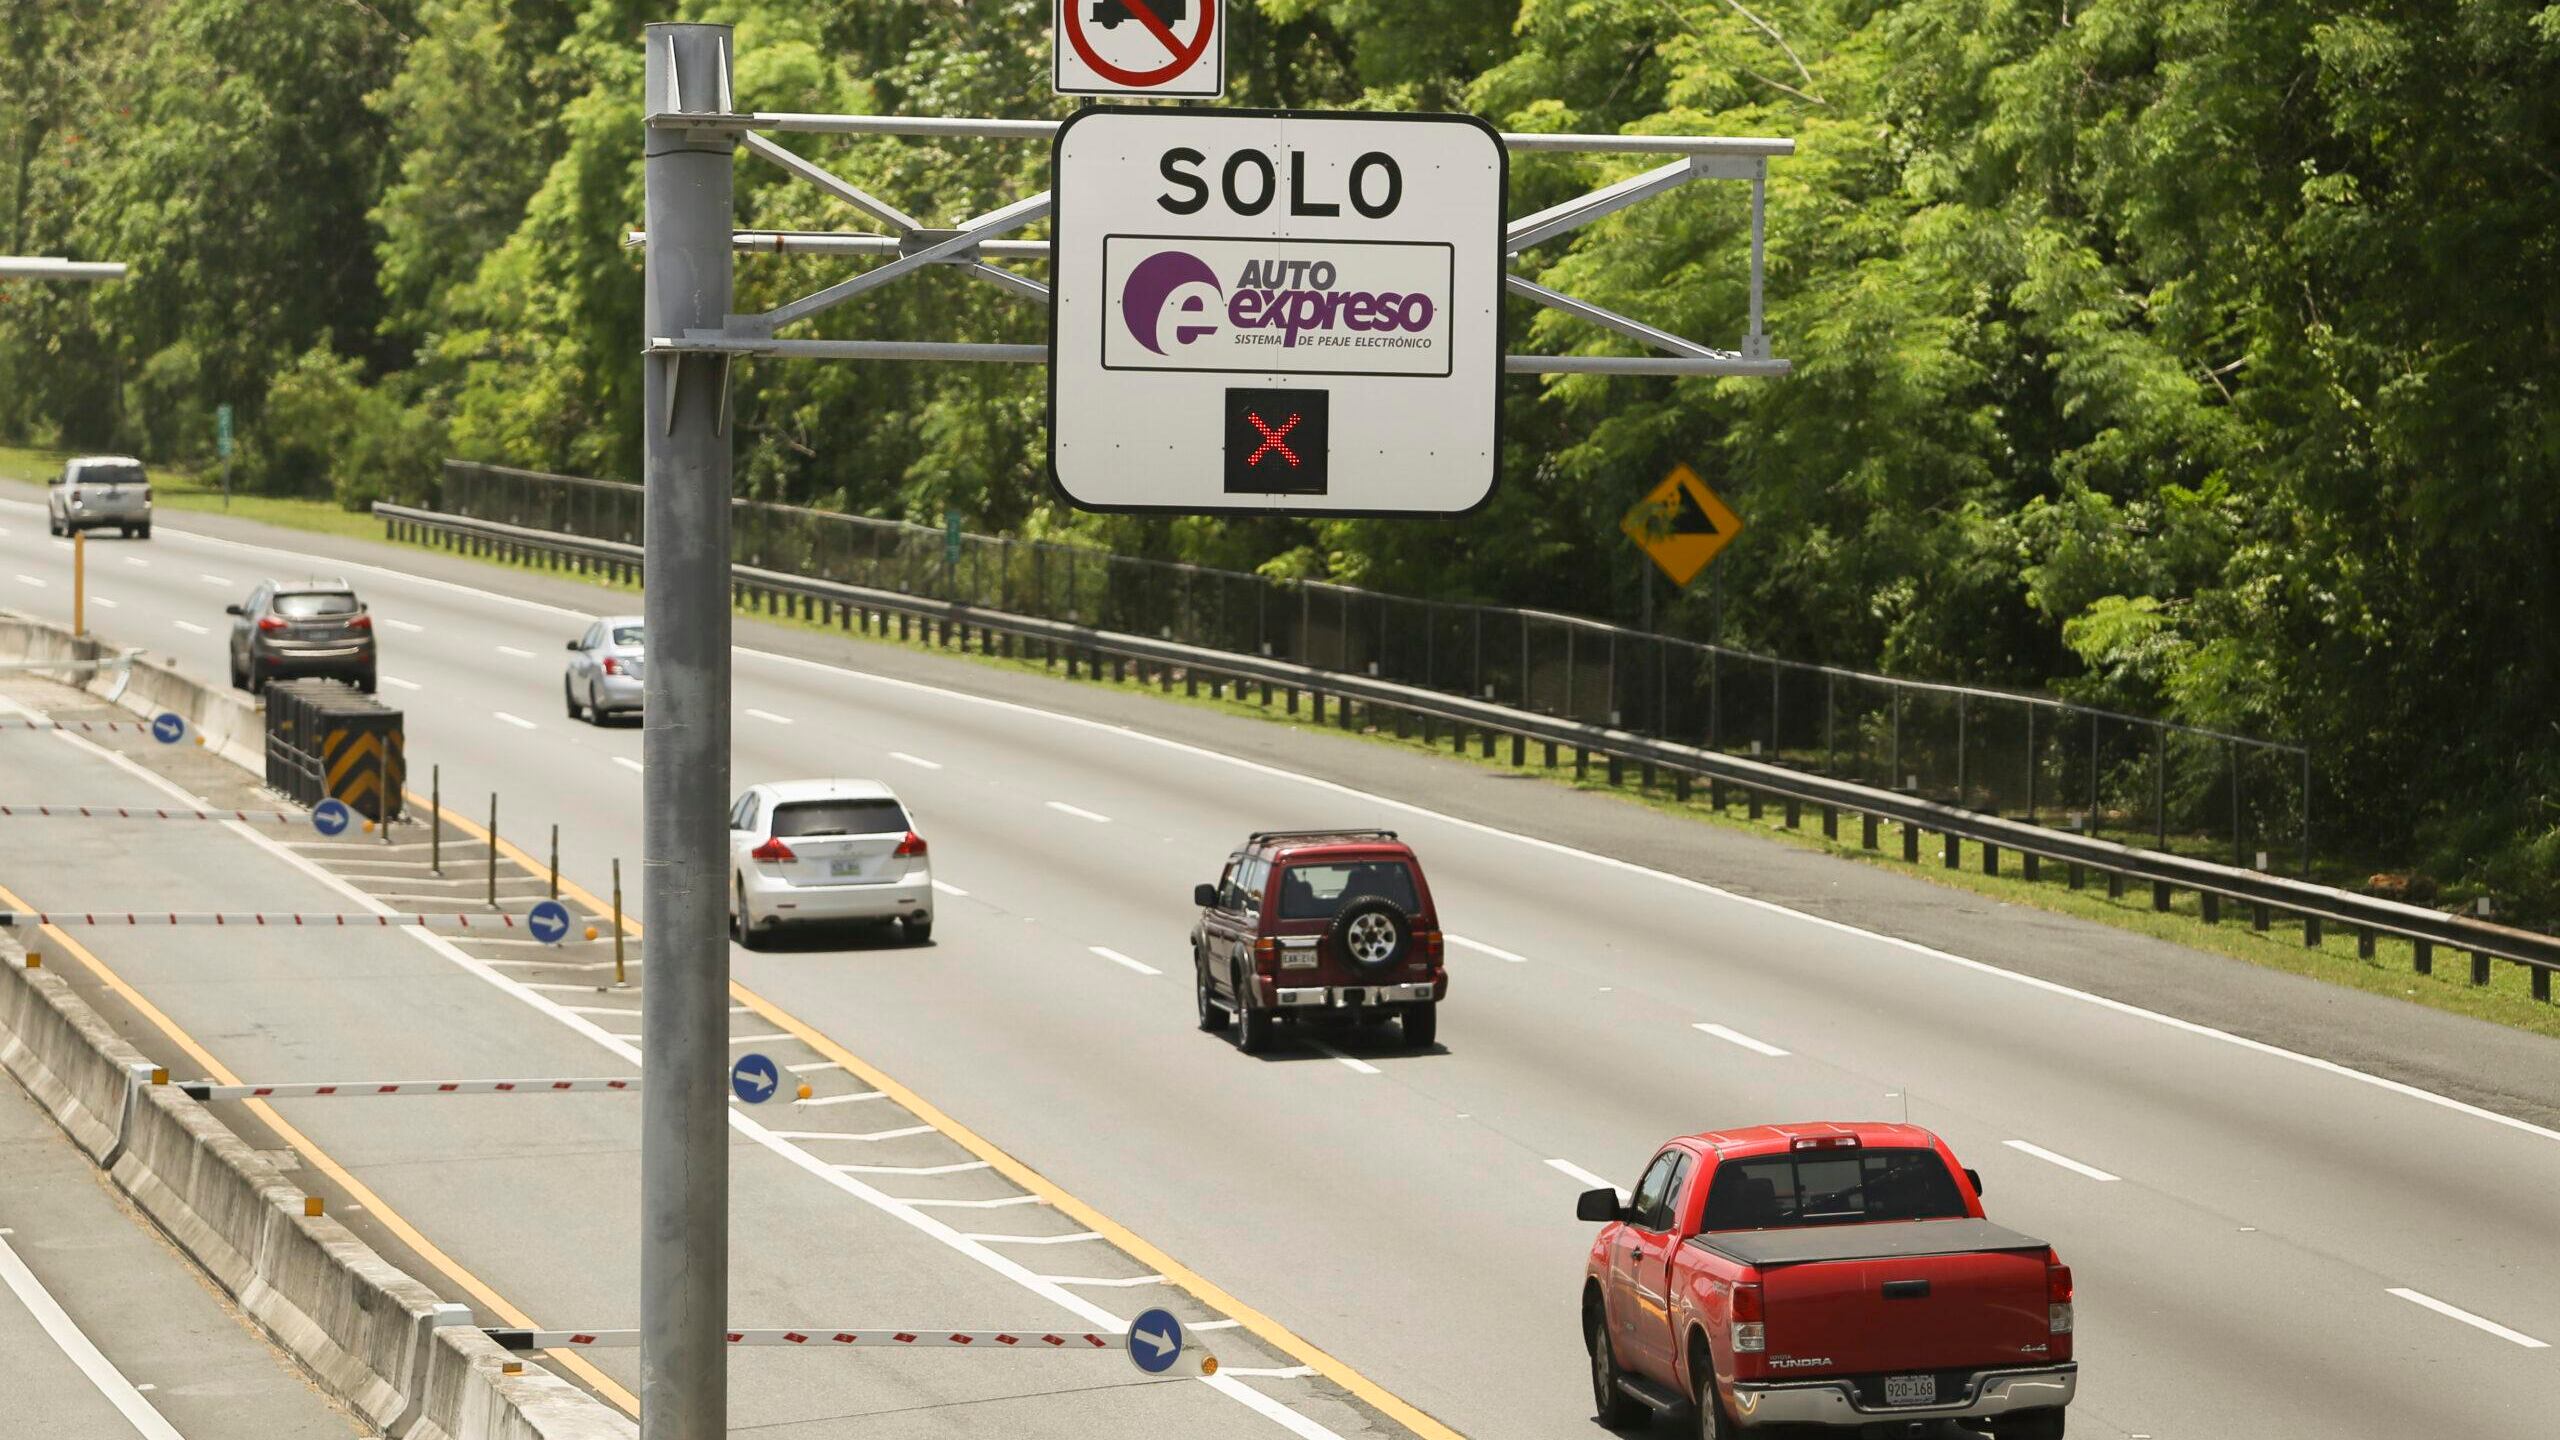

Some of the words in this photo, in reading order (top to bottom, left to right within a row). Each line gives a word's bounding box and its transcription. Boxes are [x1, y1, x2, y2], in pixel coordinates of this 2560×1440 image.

[1157, 147, 1402, 219] SOLO
[1236, 259, 1337, 290] AUTO
[1228, 288, 1434, 348] expreso
[1234, 334, 1282, 346] SISTEMA
[1297, 335, 1315, 347] DE
[1317, 336, 1351, 348] PEAJE
[1354, 336, 1432, 349] ELECTRÓNICO
[1769, 1358, 1833, 1369] TUNDRA
[1887, 1381, 1934, 1397] 920-168
